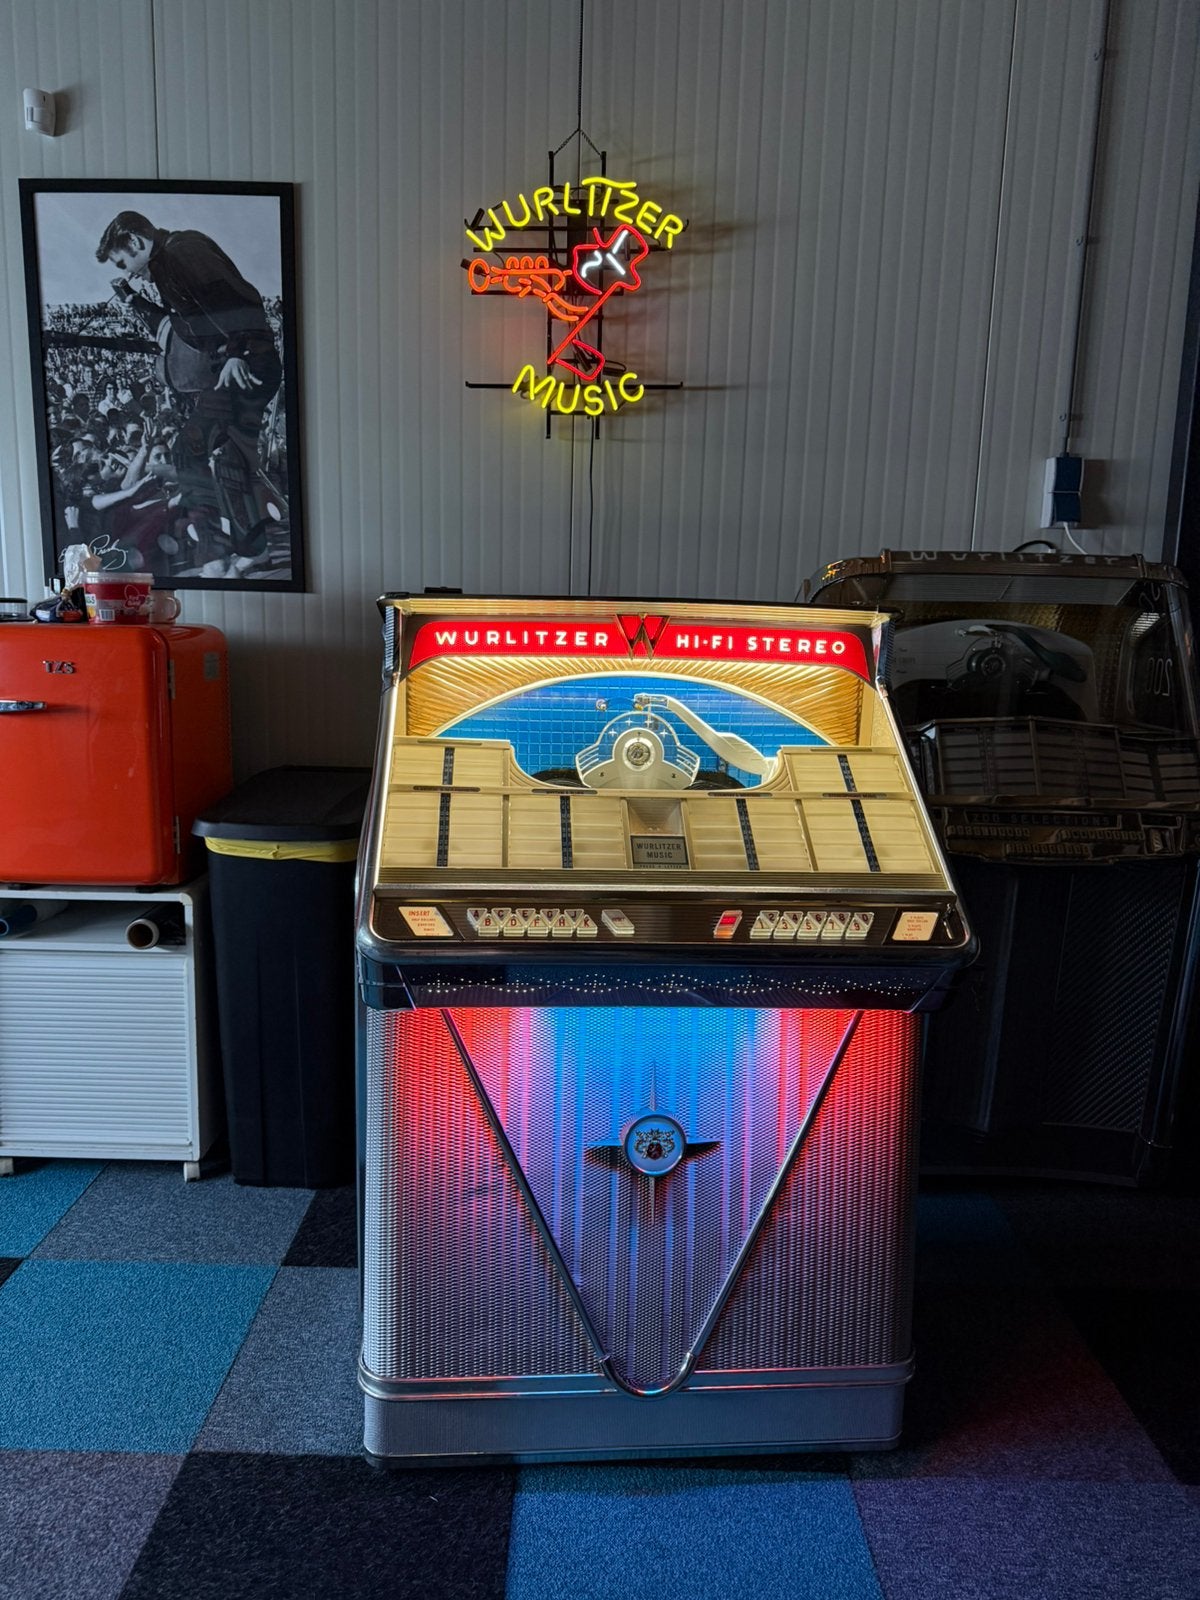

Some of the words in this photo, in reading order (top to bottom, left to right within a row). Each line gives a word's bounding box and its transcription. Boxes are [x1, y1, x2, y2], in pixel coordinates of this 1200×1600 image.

[466, 177, 683, 252] WURLITZER
[512, 364, 644, 416] MUSIC
[434, 630, 609, 648] WURLITZER
[747, 637, 847, 655] STEREO
[43, 660, 76, 674] TZS
[473, 910, 479, 918] A
[497, 909, 504, 917] C
[522, 910, 528, 918] E
[768, 913, 775, 922] 2
[792, 914, 798, 922] 4
[815, 914, 822, 922] 6
[838, 913, 845, 922] 8
[862, 913, 868, 922] 0
[534, 919, 540, 927] F
[559, 919, 566, 927] H
[584, 919, 590, 927] K
[782, 922, 788, 930] 3
[806, 922, 812, 930] 5
[830, 921, 835, 930] 7
[854, 922, 860, 931] 9
